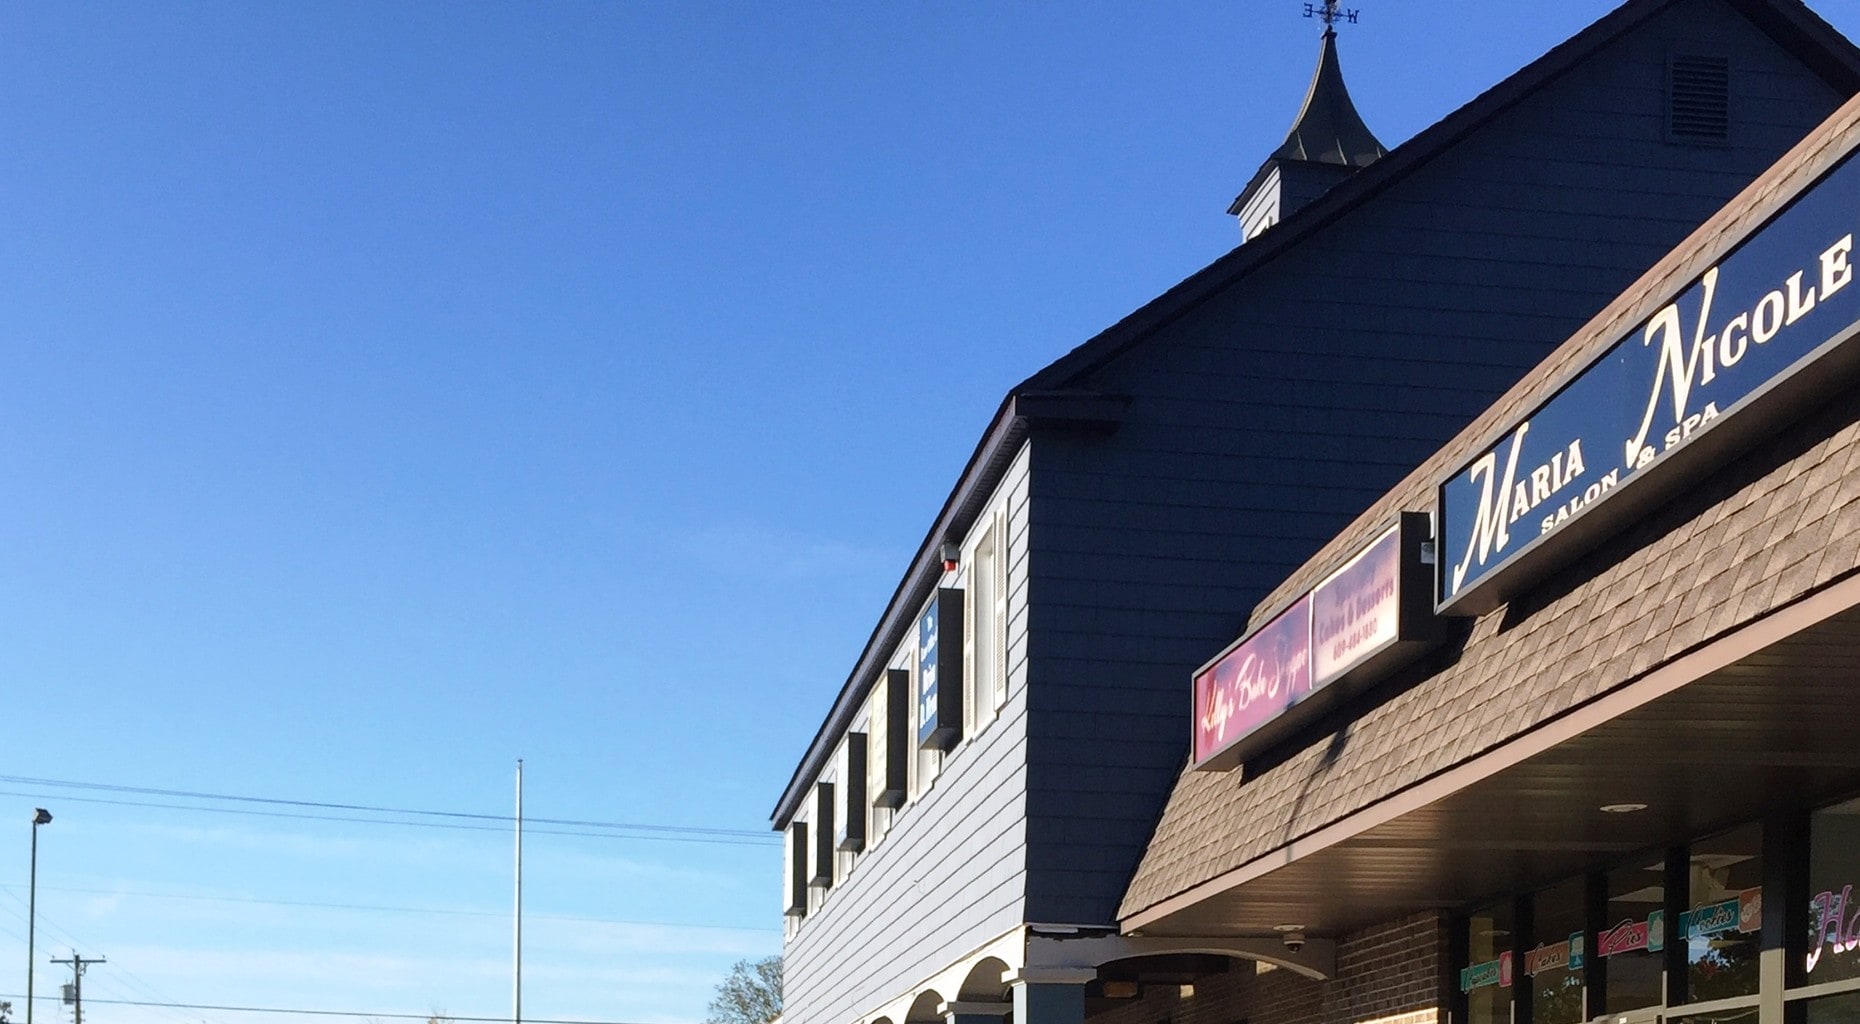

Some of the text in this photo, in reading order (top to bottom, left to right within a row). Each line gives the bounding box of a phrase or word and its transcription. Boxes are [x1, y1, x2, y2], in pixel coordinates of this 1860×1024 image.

[1452, 233, 1853, 596] MARIA NICOLE
[1541, 401, 1720, 536] SALON & SPA
[1602, 918, 1642, 960] Pies
[1684, 901, 1735, 943] Cookies
